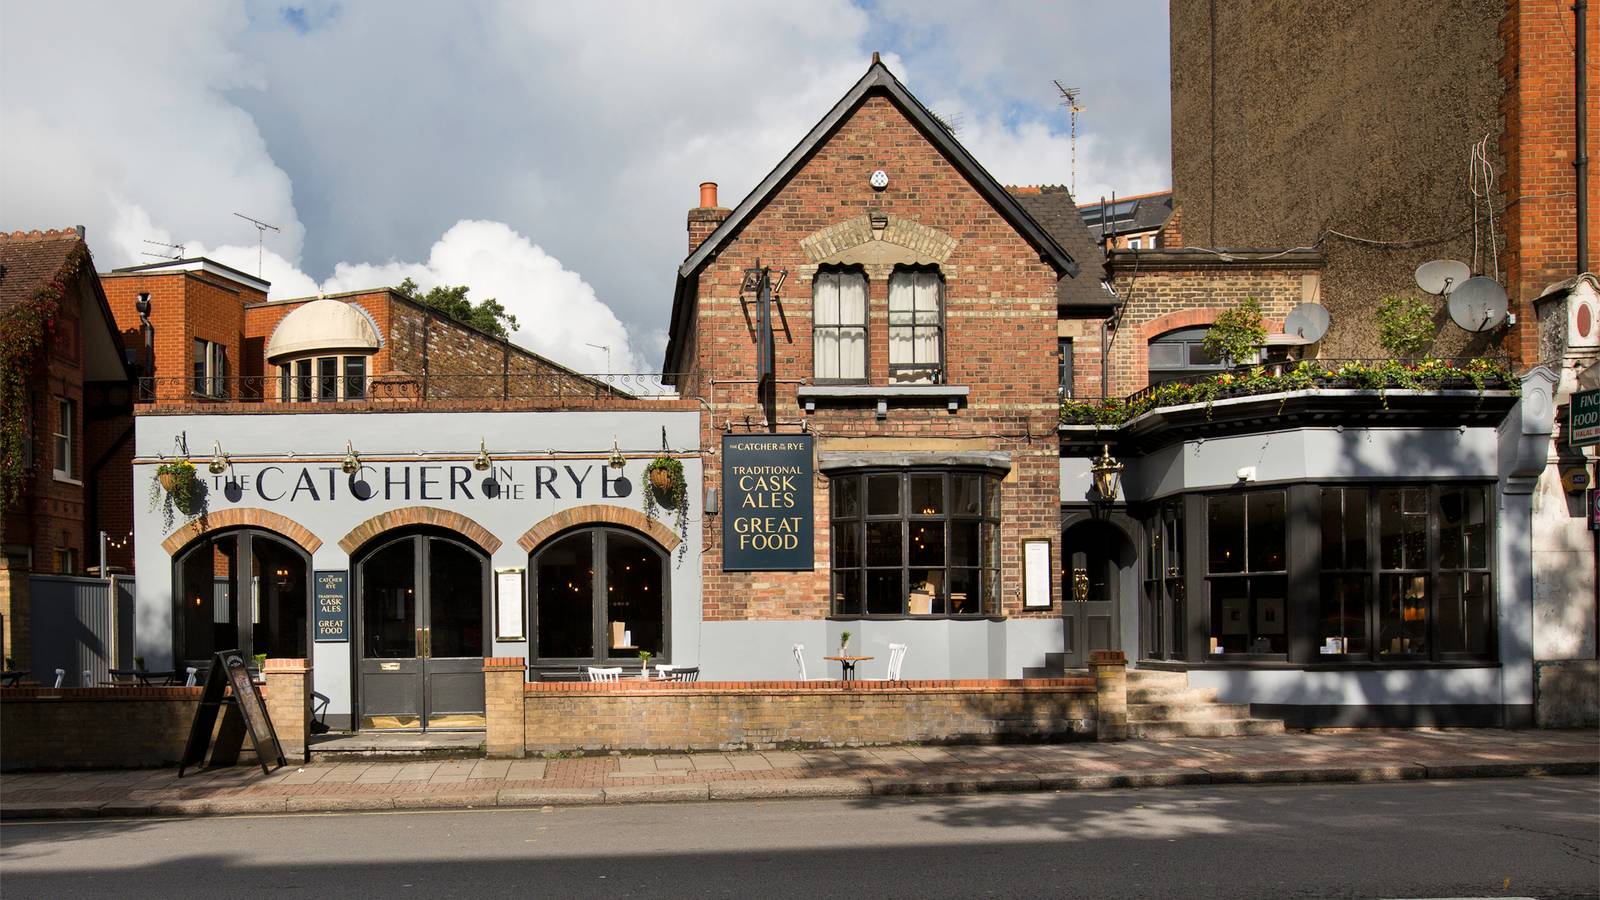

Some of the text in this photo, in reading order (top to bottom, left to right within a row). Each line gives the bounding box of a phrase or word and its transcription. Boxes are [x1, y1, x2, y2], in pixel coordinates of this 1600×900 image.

[1574, 412, 1598, 427] FOOD
[737, 442, 778, 451] CATCHER
[787, 442, 805, 451] RYE
[732, 466, 803, 475] TRADITIONAL
[212, 465, 625, 502] THE CATCHER IN THE RYE
[740, 475, 798, 492] CASK
[742, 492, 795, 508] ALES
[734, 517, 803, 533] GREAT
[741, 534, 798, 550] FOOD
